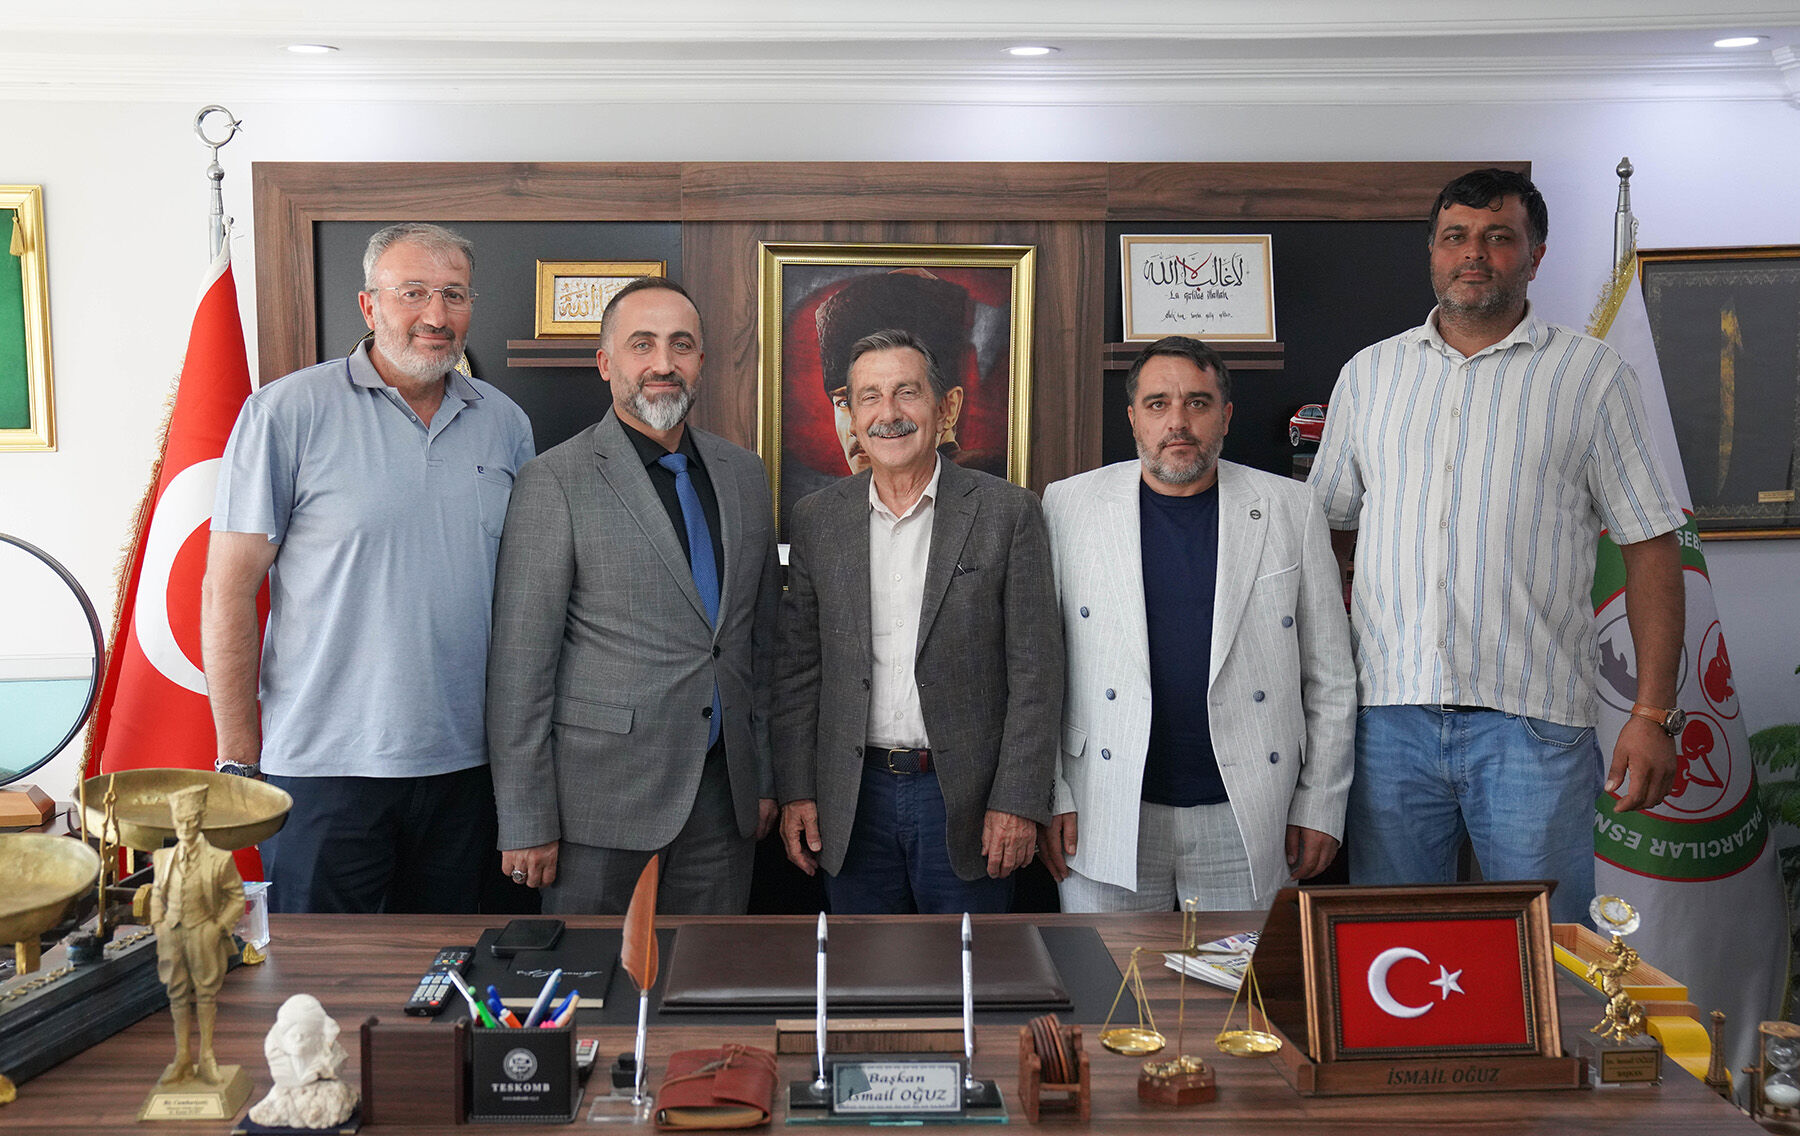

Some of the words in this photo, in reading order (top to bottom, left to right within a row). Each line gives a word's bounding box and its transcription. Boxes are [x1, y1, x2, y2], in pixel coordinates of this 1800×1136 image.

[1650, 804, 1762, 860] PAZARCILAR
[869, 1071, 925, 1086] Başkan
[1387, 1067, 1447, 1086] İSMAİL
[1451, 1065, 1501, 1084] OĞUZ
[491, 1083, 551, 1093] TESKOMB
[900, 1087, 948, 1104] OĞUZ
